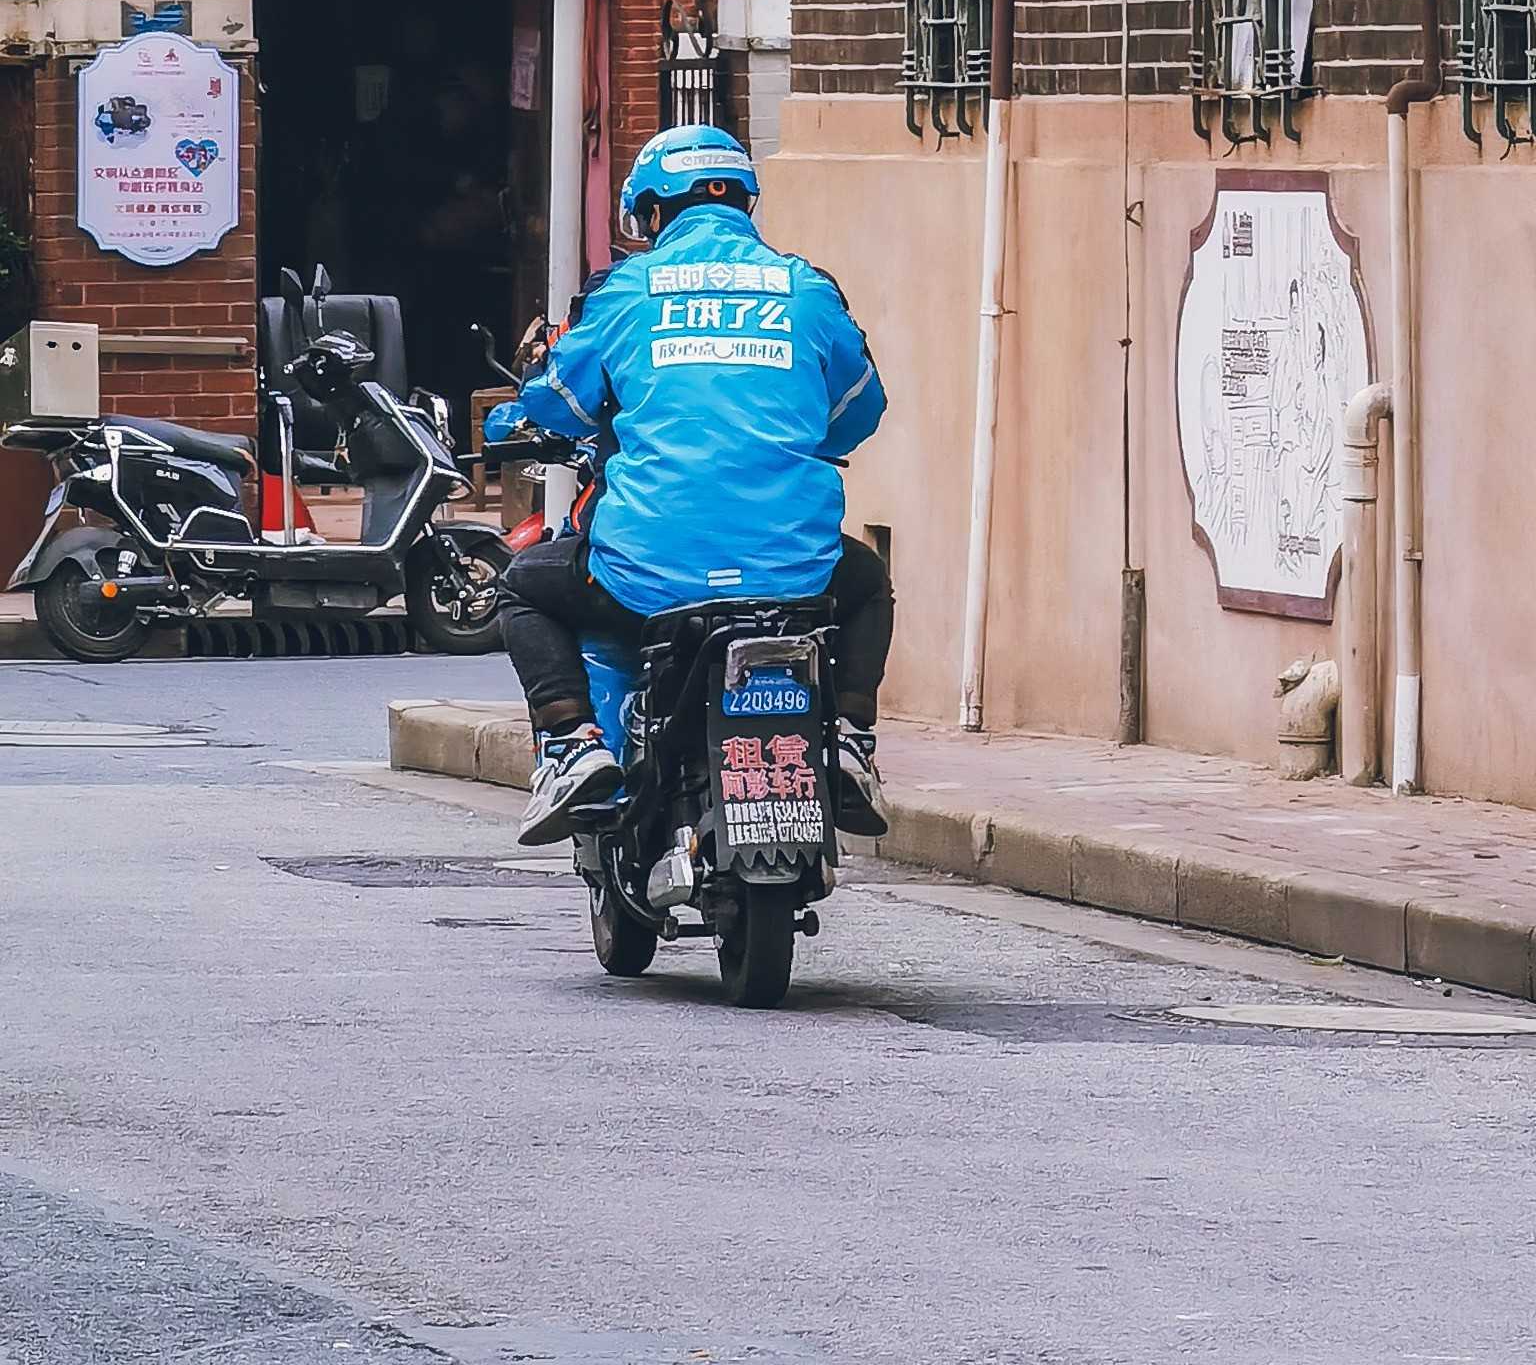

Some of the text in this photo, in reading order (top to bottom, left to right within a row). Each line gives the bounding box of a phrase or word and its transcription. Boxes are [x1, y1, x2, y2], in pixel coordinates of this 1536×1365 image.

[650, 298, 792, 332] 上饿了么
[721, 735, 809, 769] 租赁
